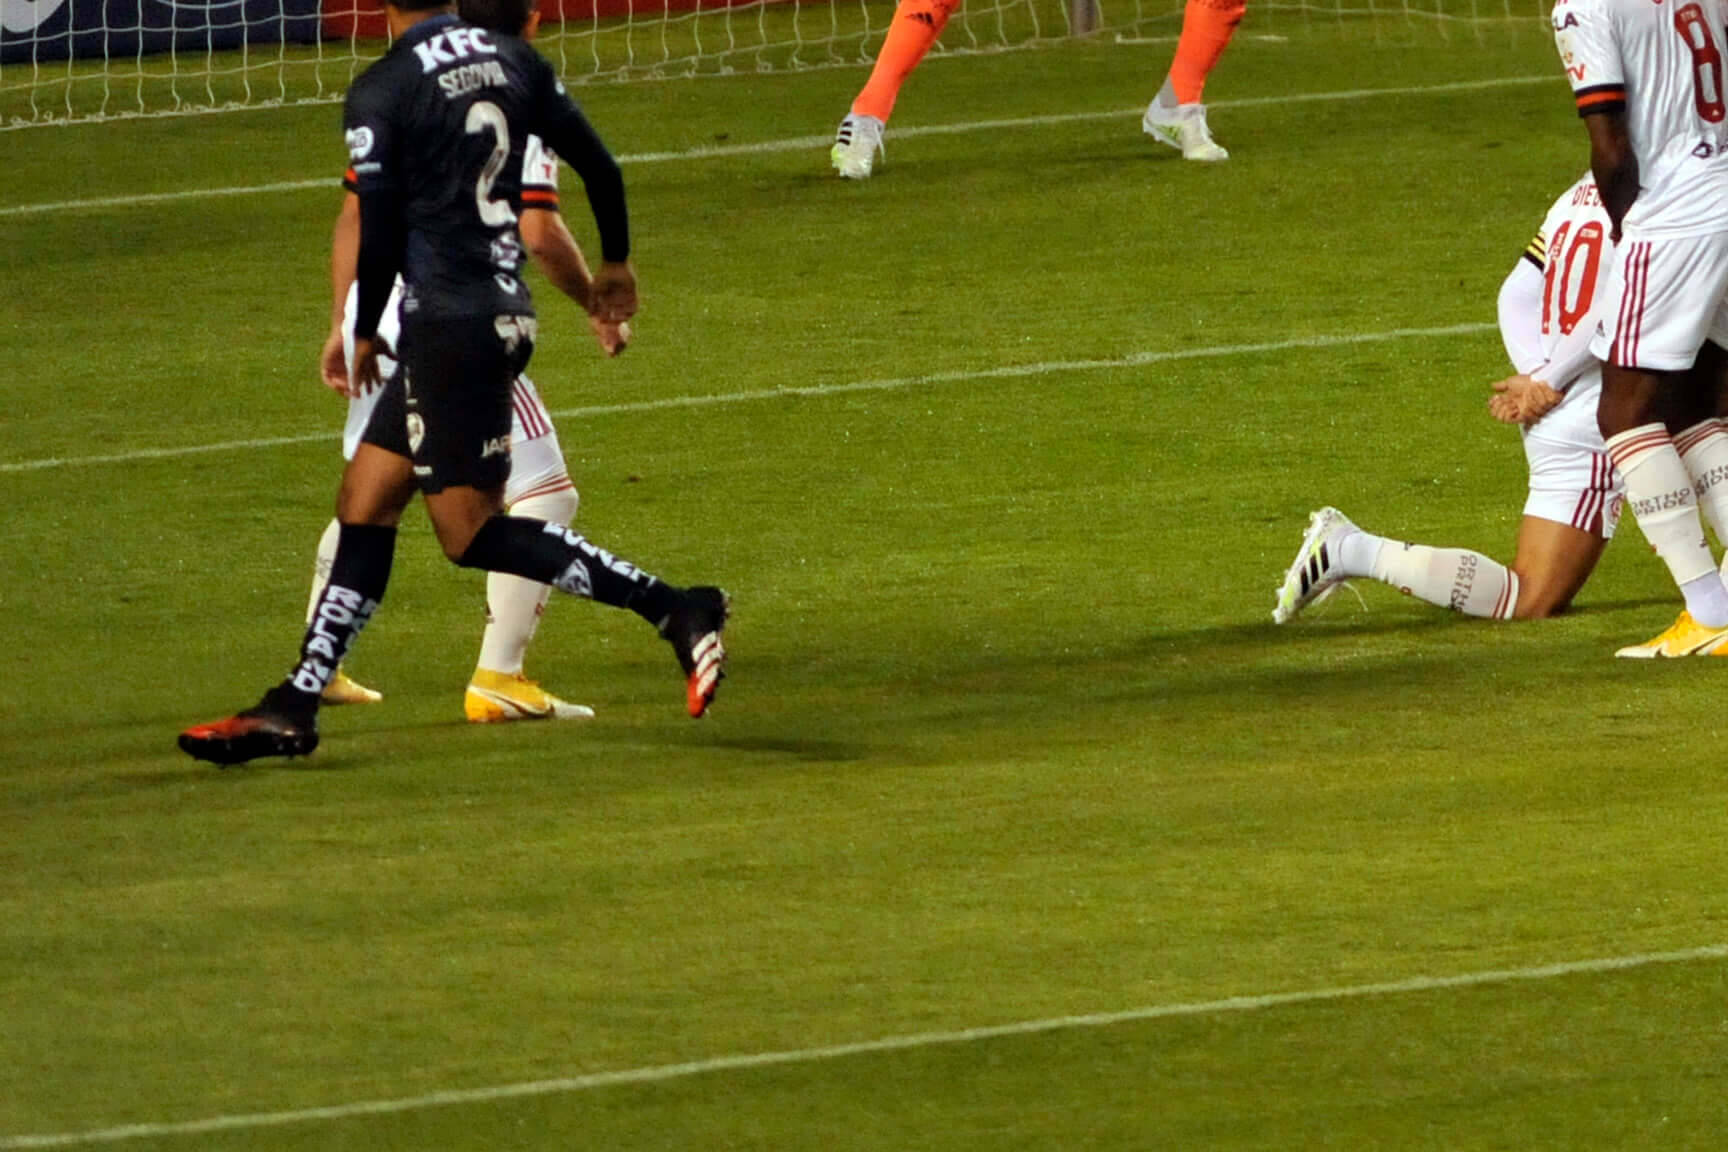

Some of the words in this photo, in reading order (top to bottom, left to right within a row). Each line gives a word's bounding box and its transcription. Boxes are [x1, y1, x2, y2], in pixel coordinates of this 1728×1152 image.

[413, 26, 497, 74] KFC
[1552, 11, 1579, 32] LA
[1674, 2, 1726, 123] 8
[438, 60, 508, 99] SEGOVIA
[465, 101, 518, 227] 2
[1541, 220, 1604, 336] 10
